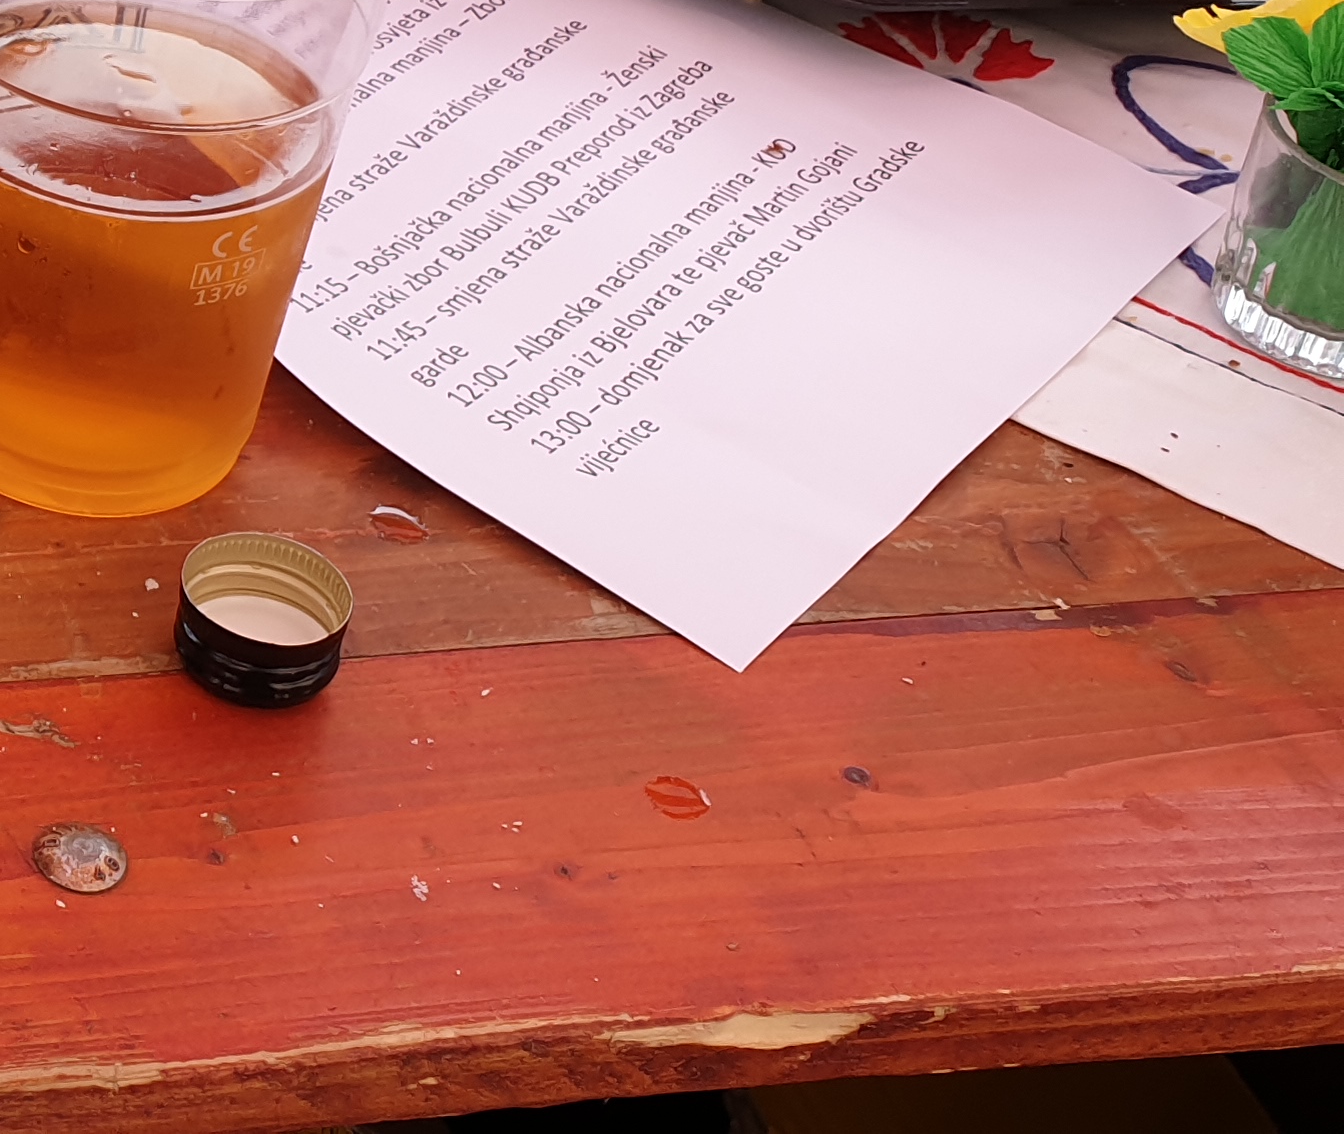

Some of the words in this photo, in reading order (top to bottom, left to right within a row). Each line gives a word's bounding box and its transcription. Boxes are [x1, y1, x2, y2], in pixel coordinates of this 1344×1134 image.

[315, 189, 354, 223] jena
[348, 150, 408, 191] straže
[395, 77, 507, 149] Varaždinske
[501, 20, 588, 82] građanske
[389, 27, 461, 74] manjina
[196, 264, 227, 285] M
[230, 257, 257, 277] 19
[212, 225, 259, 257] CE
[285, 277, 349, 313] 11:15
[353, 210, 453, 275] Bošnjačka
[446, 139, 544, 212] nacionalna
[536, 91, 609, 142] manjina
[600, 44, 668, 88] Ženski
[330, 284, 410, 341] pjevački
[402, 257, 449, 292] zbor
[439, 208, 512, 261] Bulbuli
[499, 171, 560, 214] KUDB
[549, 113, 637, 176] Preporod
[623, 106, 652, 121] iz
[638, 60, 713, 110] Zagreba
[366, 320, 427, 361] 11:45
[436, 267, 508, 317] smjena
[501, 224, 561, 269] straže
[547, 149, 657, 223] Varaždinske
[650, 92, 735, 154] građanske
[193, 279, 249, 307] 1376
[410, 345, 469, 388] garde
[447, 364, 508, 408] 12:00
[513, 296, 603, 362] Albanska
[594, 223, 692, 298] nacionalna
[683, 172, 755, 225] manjina
[486, 365, 586, 431] Shqiponja
[571, 350, 604, 368] iz
[589, 283, 683, 353] Bjelovara
[671, 267, 703, 284] te
[694, 219, 756, 272] pjevač
[742, 182, 809, 226] Martin
[796, 141, 858, 184] Gojani
[530, 410, 592, 454] 13:00
[597, 330, 695, 406] domjenak
[684, 313, 715, 334] za
[706, 288, 744, 315] sve
[736, 250, 789, 293] goste
[780, 238, 803, 252] u
[792, 190, 865, 241] dvorištu
[852, 141, 925, 192] Gradske
[575, 419, 660, 477] vijećnice
